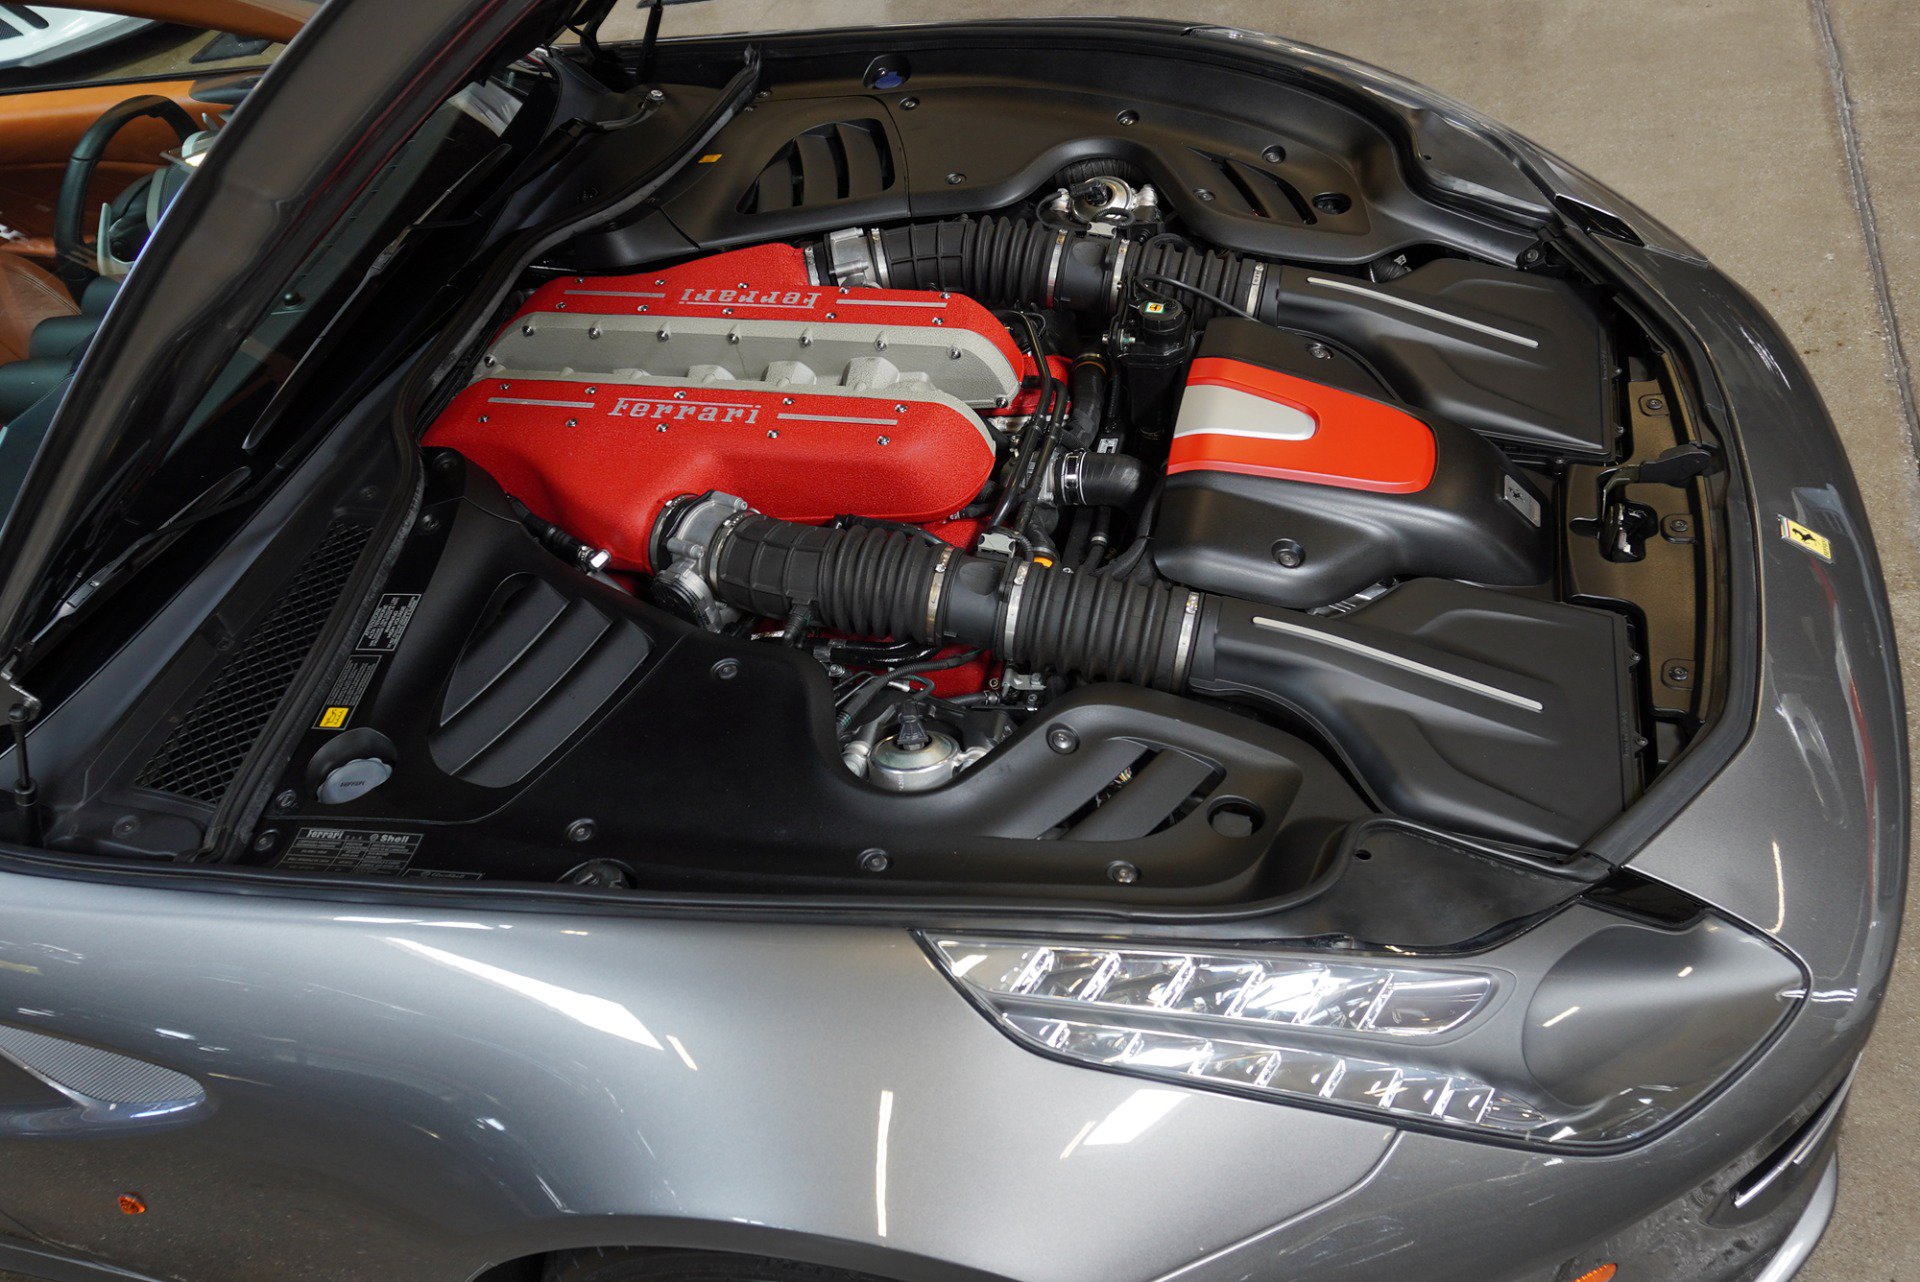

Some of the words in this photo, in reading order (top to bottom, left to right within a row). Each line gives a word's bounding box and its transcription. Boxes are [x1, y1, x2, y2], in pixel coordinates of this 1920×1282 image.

[678, 288, 822, 309] Ferrari
[607, 397, 761, 424] Ferrari
[306, 828, 345, 840] Ferrari
[380, 834, 409, 844] Shell
